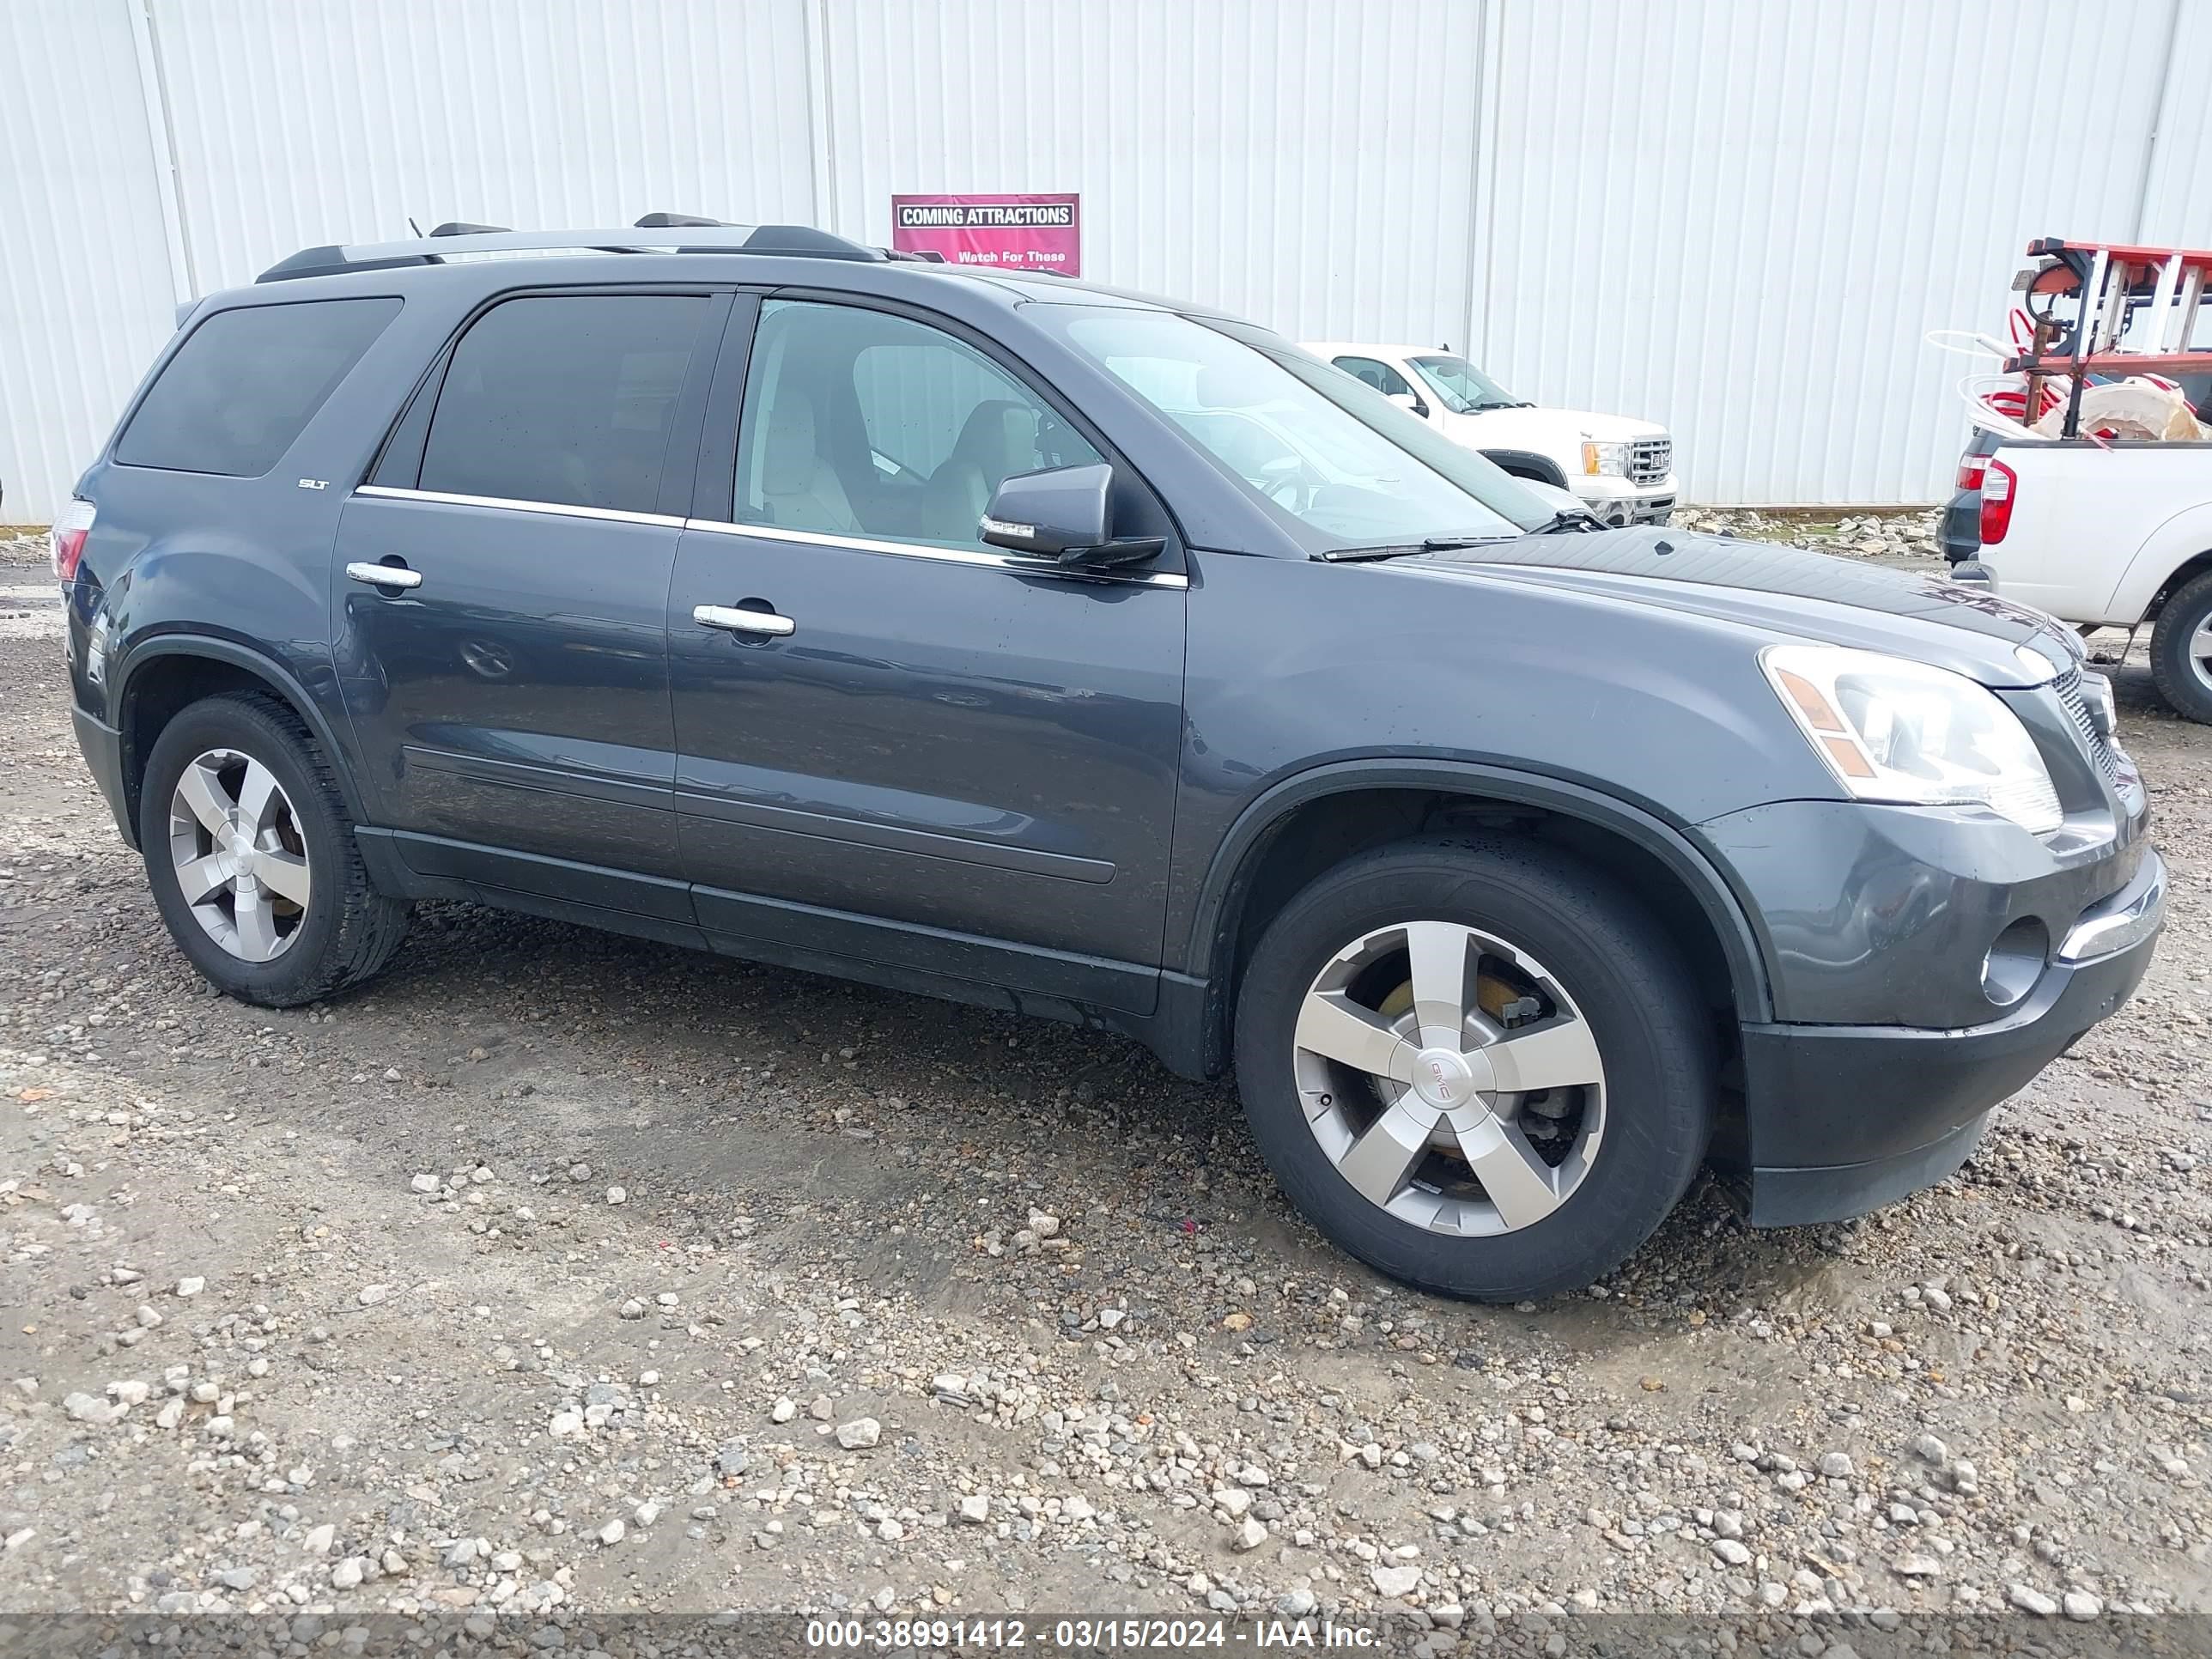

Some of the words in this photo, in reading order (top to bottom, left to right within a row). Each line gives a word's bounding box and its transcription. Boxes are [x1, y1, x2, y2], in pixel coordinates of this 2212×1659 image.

[902, 208, 963, 225] COMING
[966, 207, 1069, 225] ATTRACTIONS
[958, 251, 998, 263] Watch
[1002, 251, 1024, 263] For
[1026, 250, 1066, 262] These
[298, 478, 330, 490] SLT
[1431, 1063, 1450, 1099] GMC
